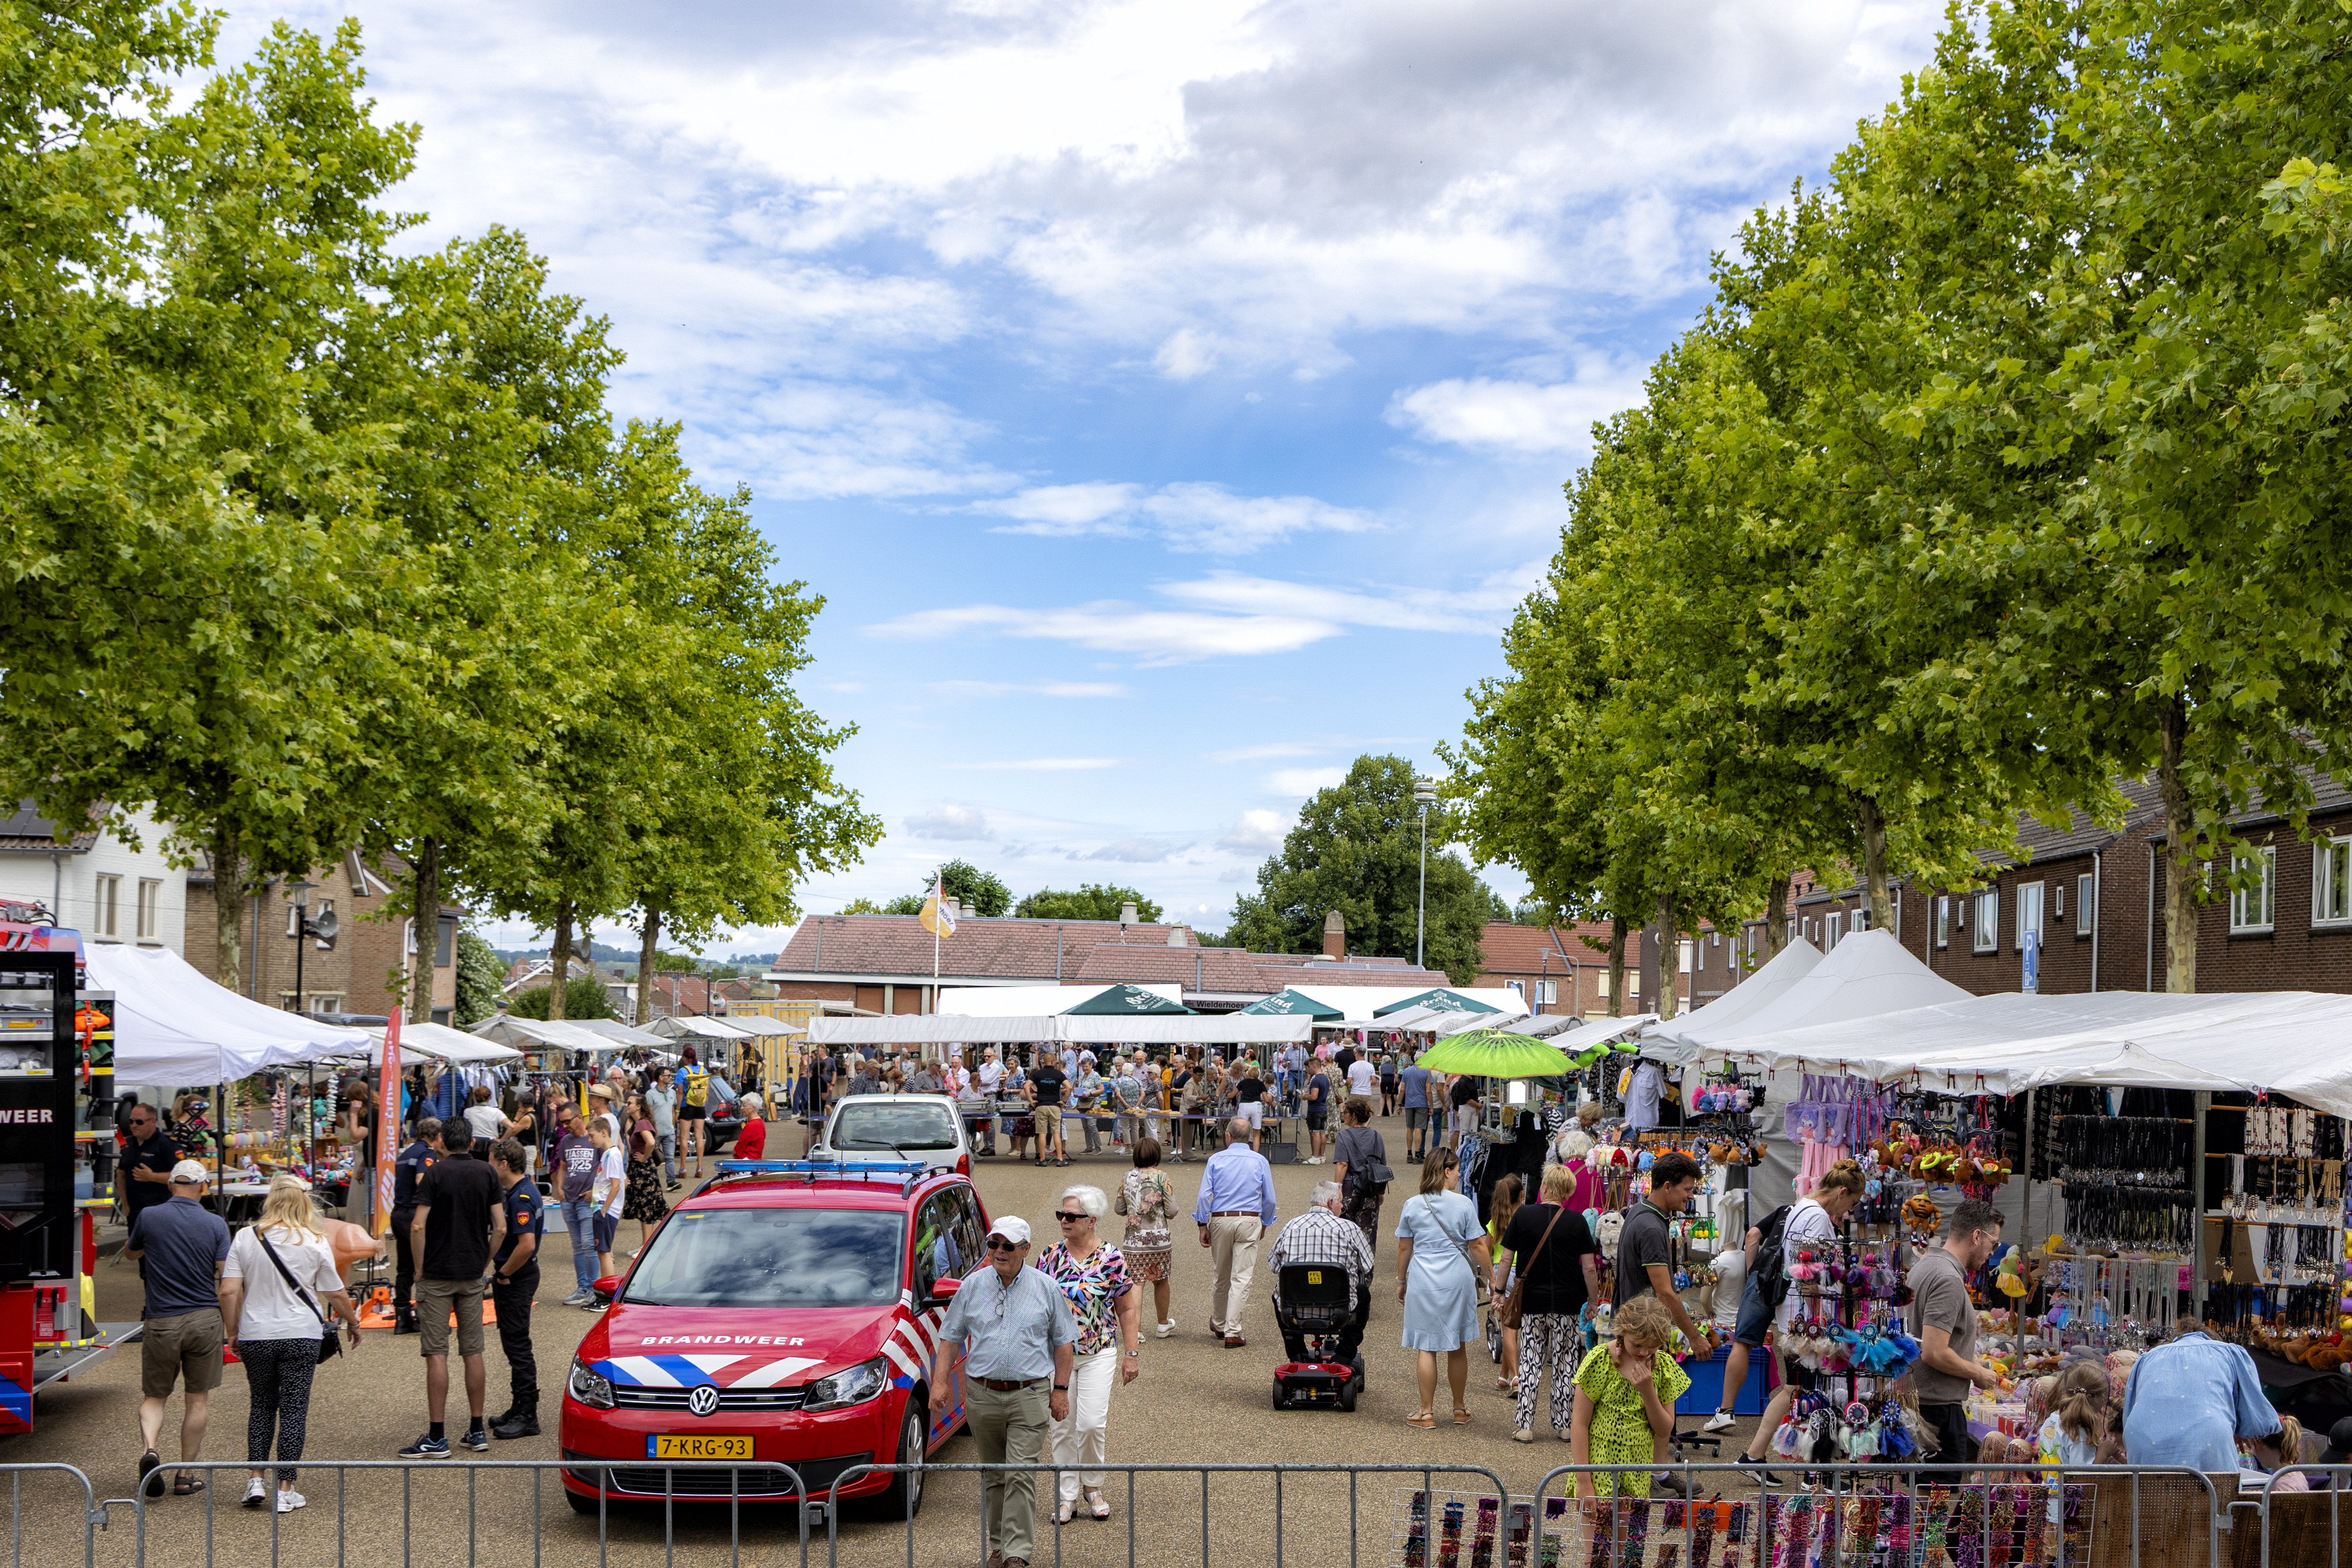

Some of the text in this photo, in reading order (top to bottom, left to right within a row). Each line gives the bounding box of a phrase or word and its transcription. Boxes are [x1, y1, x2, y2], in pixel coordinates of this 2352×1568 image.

[2026, 934, 2032, 961] P
[1197, 1000, 1245, 1008] Wielderhoes
[570, 1160, 592, 1170] 1925
[641, 1335, 805, 1346] BRANDWEER
[662, 1438, 745, 1455] 7-KRG-93
